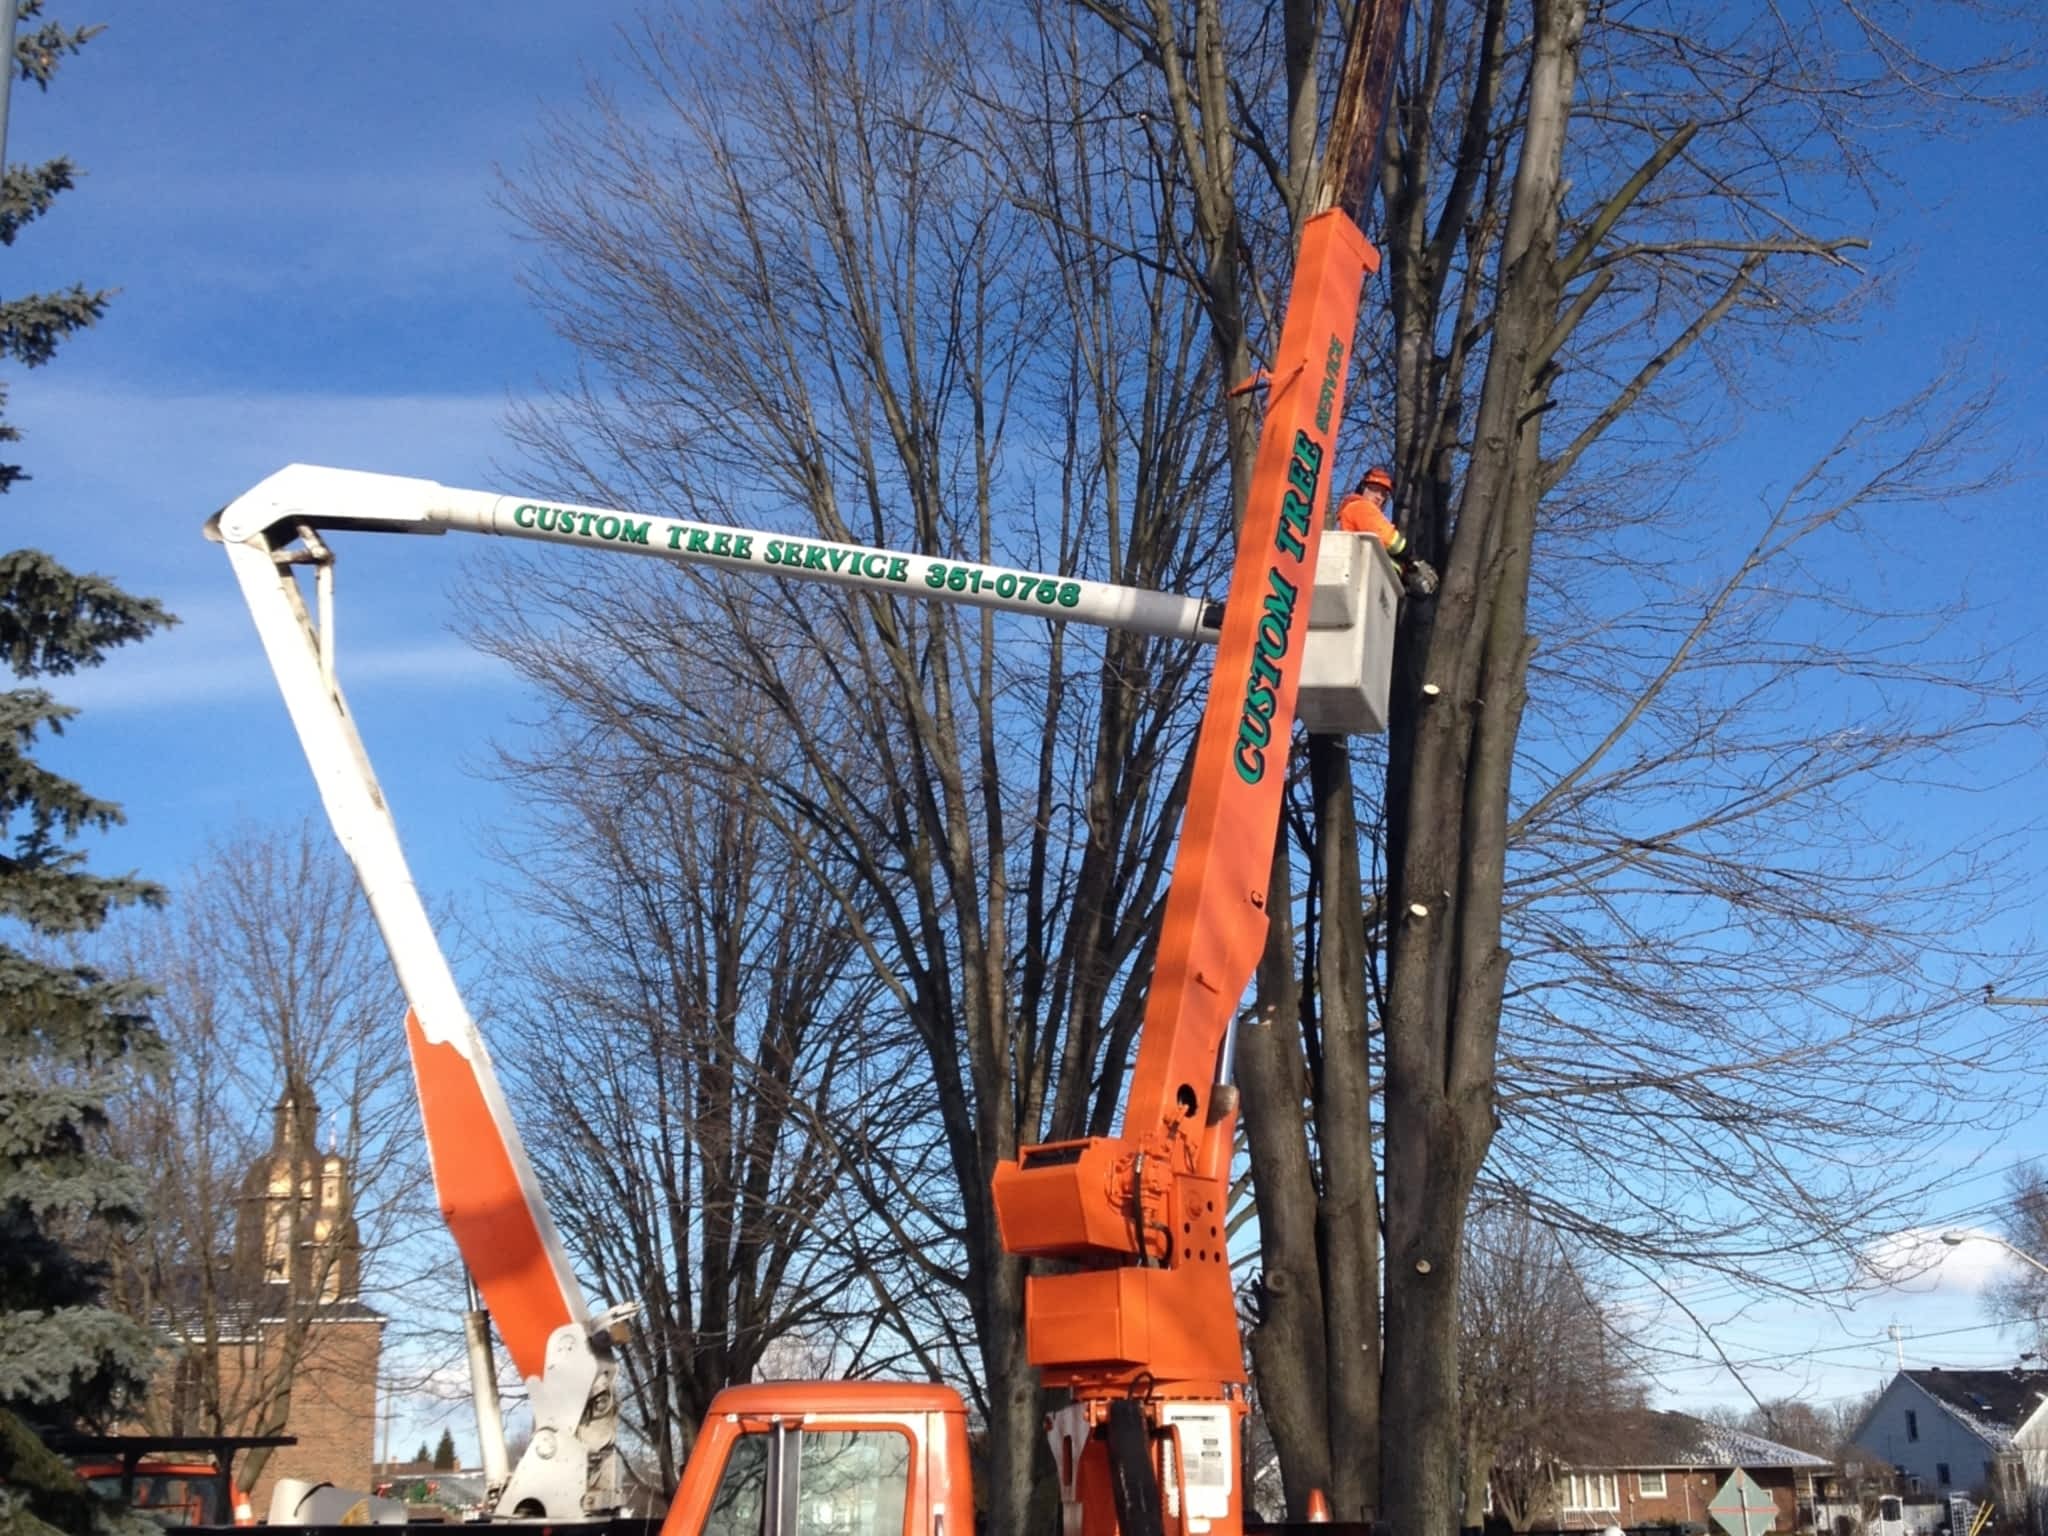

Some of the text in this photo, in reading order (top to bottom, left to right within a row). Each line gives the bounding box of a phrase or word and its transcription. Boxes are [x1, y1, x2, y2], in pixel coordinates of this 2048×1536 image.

[513, 504, 1081, 607] CUSTOM TREE SERVICE 351-0758
[1234, 334, 1345, 784] CUSTOM TREE SERVICE
